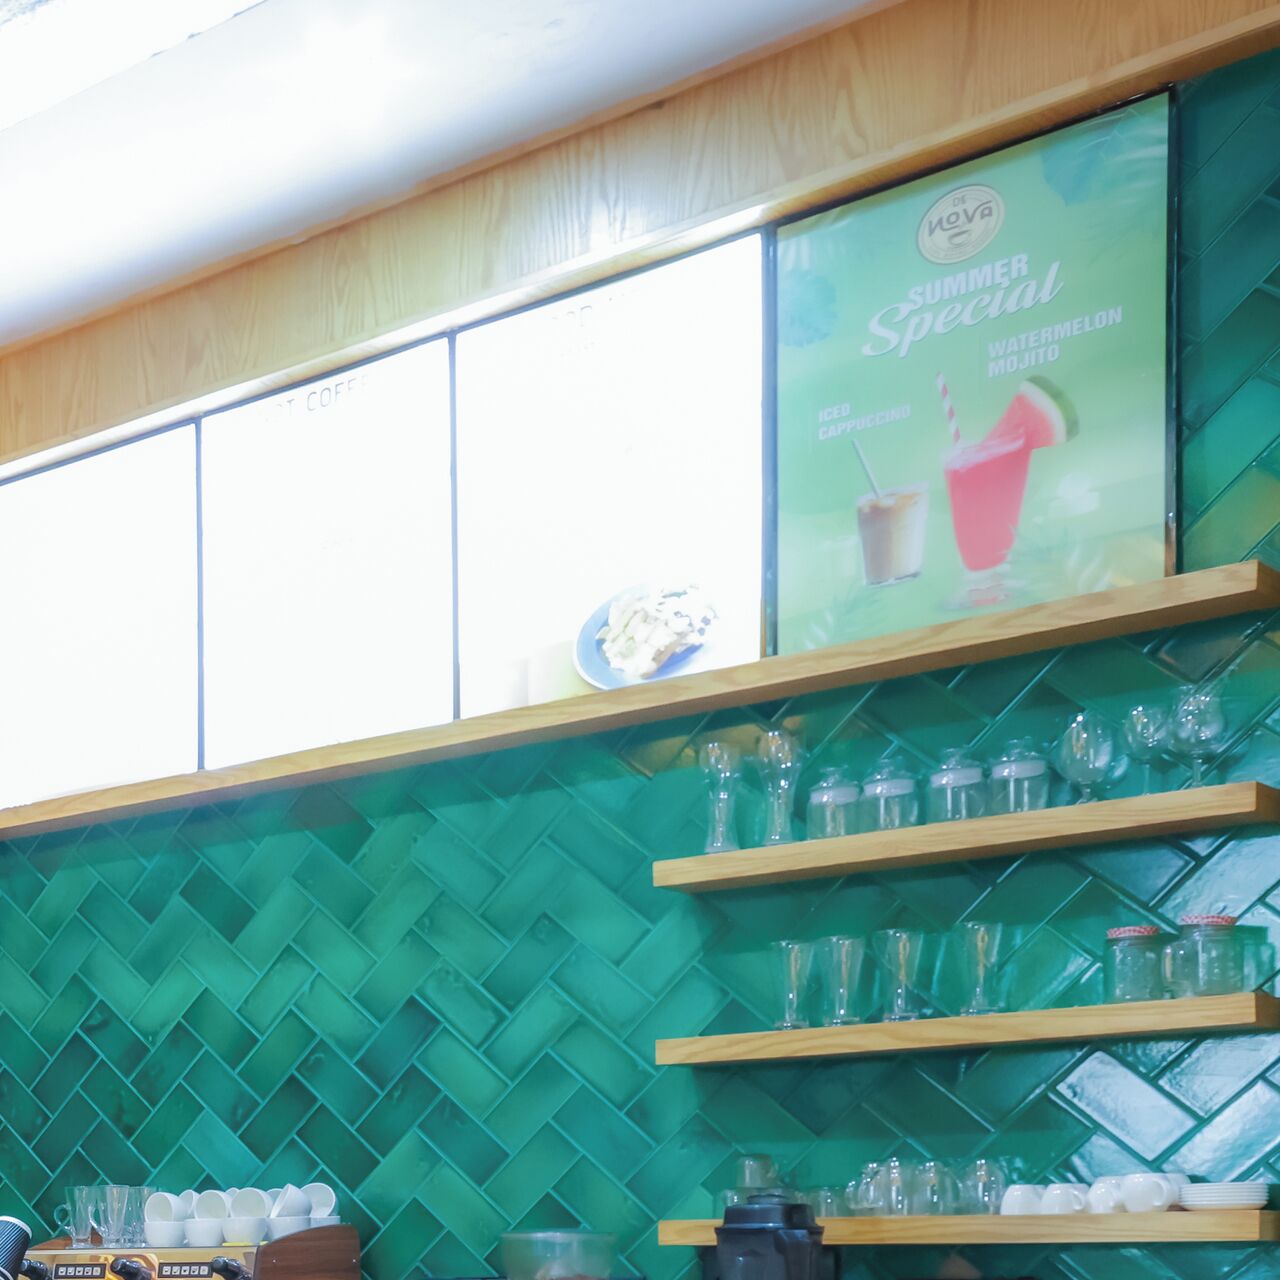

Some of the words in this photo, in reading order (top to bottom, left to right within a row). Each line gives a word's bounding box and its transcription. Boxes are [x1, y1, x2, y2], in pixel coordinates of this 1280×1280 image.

[928, 200, 993, 237] NOVA
[952, 195, 967, 207] DE
[907, 253, 1029, 306] SUMMER
[861, 261, 1065, 359] Special
[988, 305, 1123, 358] WATERMELON
[988, 344, 1060, 378] MOJITO
[818, 403, 851, 423] ICED
[818, 404, 912, 440] CAPPUCCINO
